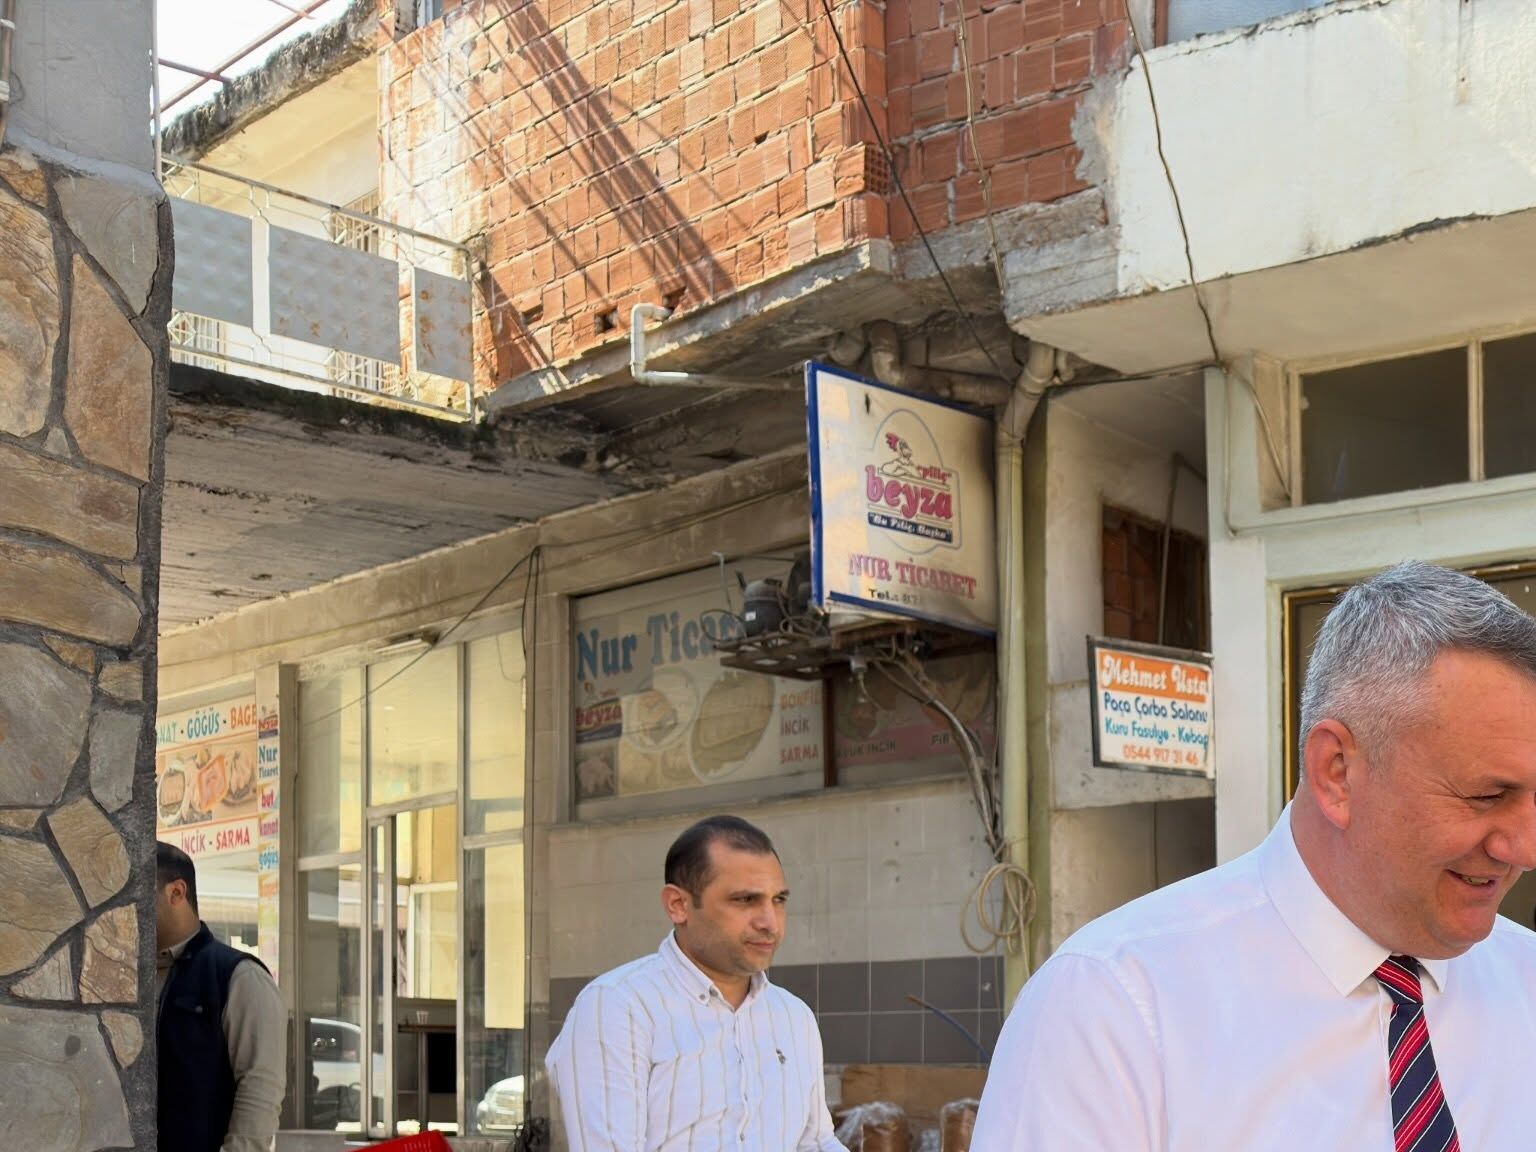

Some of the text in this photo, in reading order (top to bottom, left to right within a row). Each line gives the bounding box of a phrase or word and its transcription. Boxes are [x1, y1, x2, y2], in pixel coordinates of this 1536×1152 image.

[865, 464, 953, 519] beyza
[848, 553, 977, 600] NUR TİCARET
[577, 611, 740, 681] Nur Ticar
[1101, 654, 1168, 690] Mehmet
[230, 704, 256, 729] BAGE
[1135, 696, 1168, 719] Çorba
[1105, 717, 1129, 736] Kuru
[259, 745, 278, 764] Nur
[781, 744, 819, 764] SARMA
[1123, 743, 1152, 760] 0544
[261, 789, 274, 808] but
[216, 827, 250, 851] SARMA
